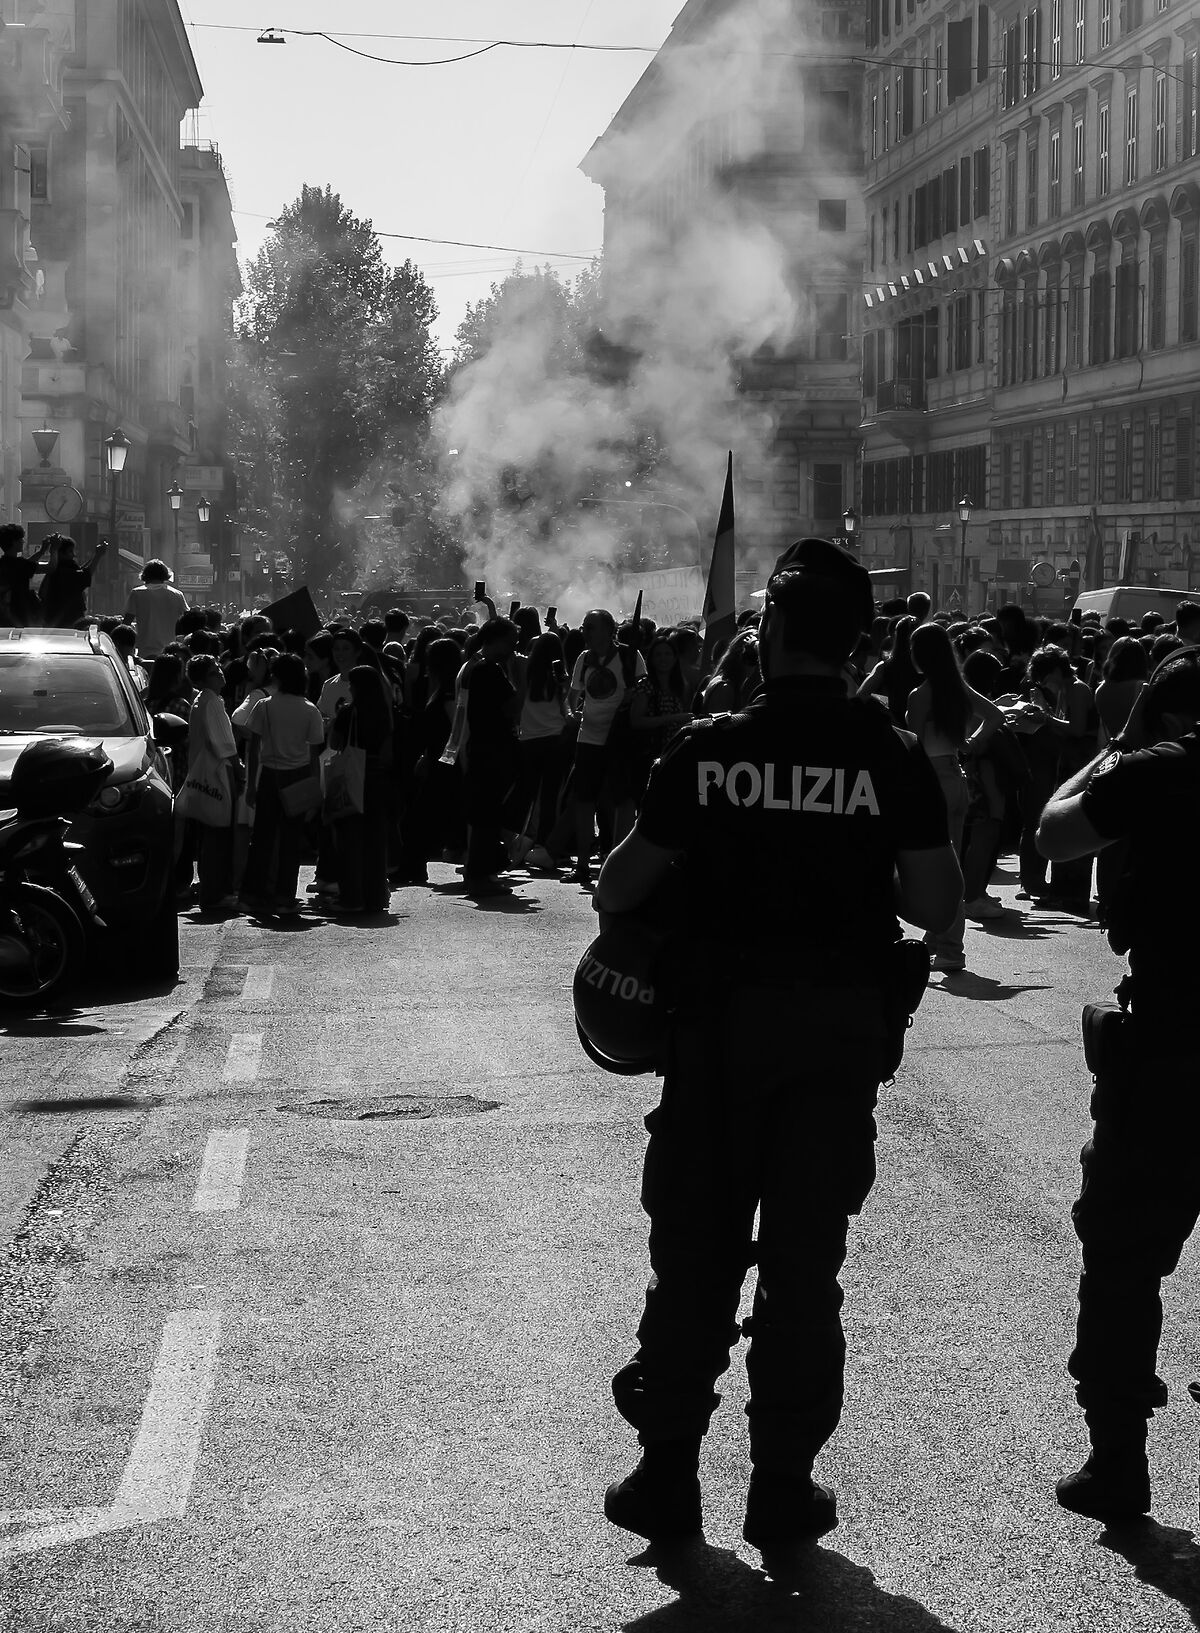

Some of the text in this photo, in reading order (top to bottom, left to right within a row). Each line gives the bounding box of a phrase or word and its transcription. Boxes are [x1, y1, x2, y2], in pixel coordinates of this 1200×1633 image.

[186, 778, 224, 801] vinokilo
[697, 761, 881, 816] POLIZIA
[580, 956, 655, 1005] POLIZI
